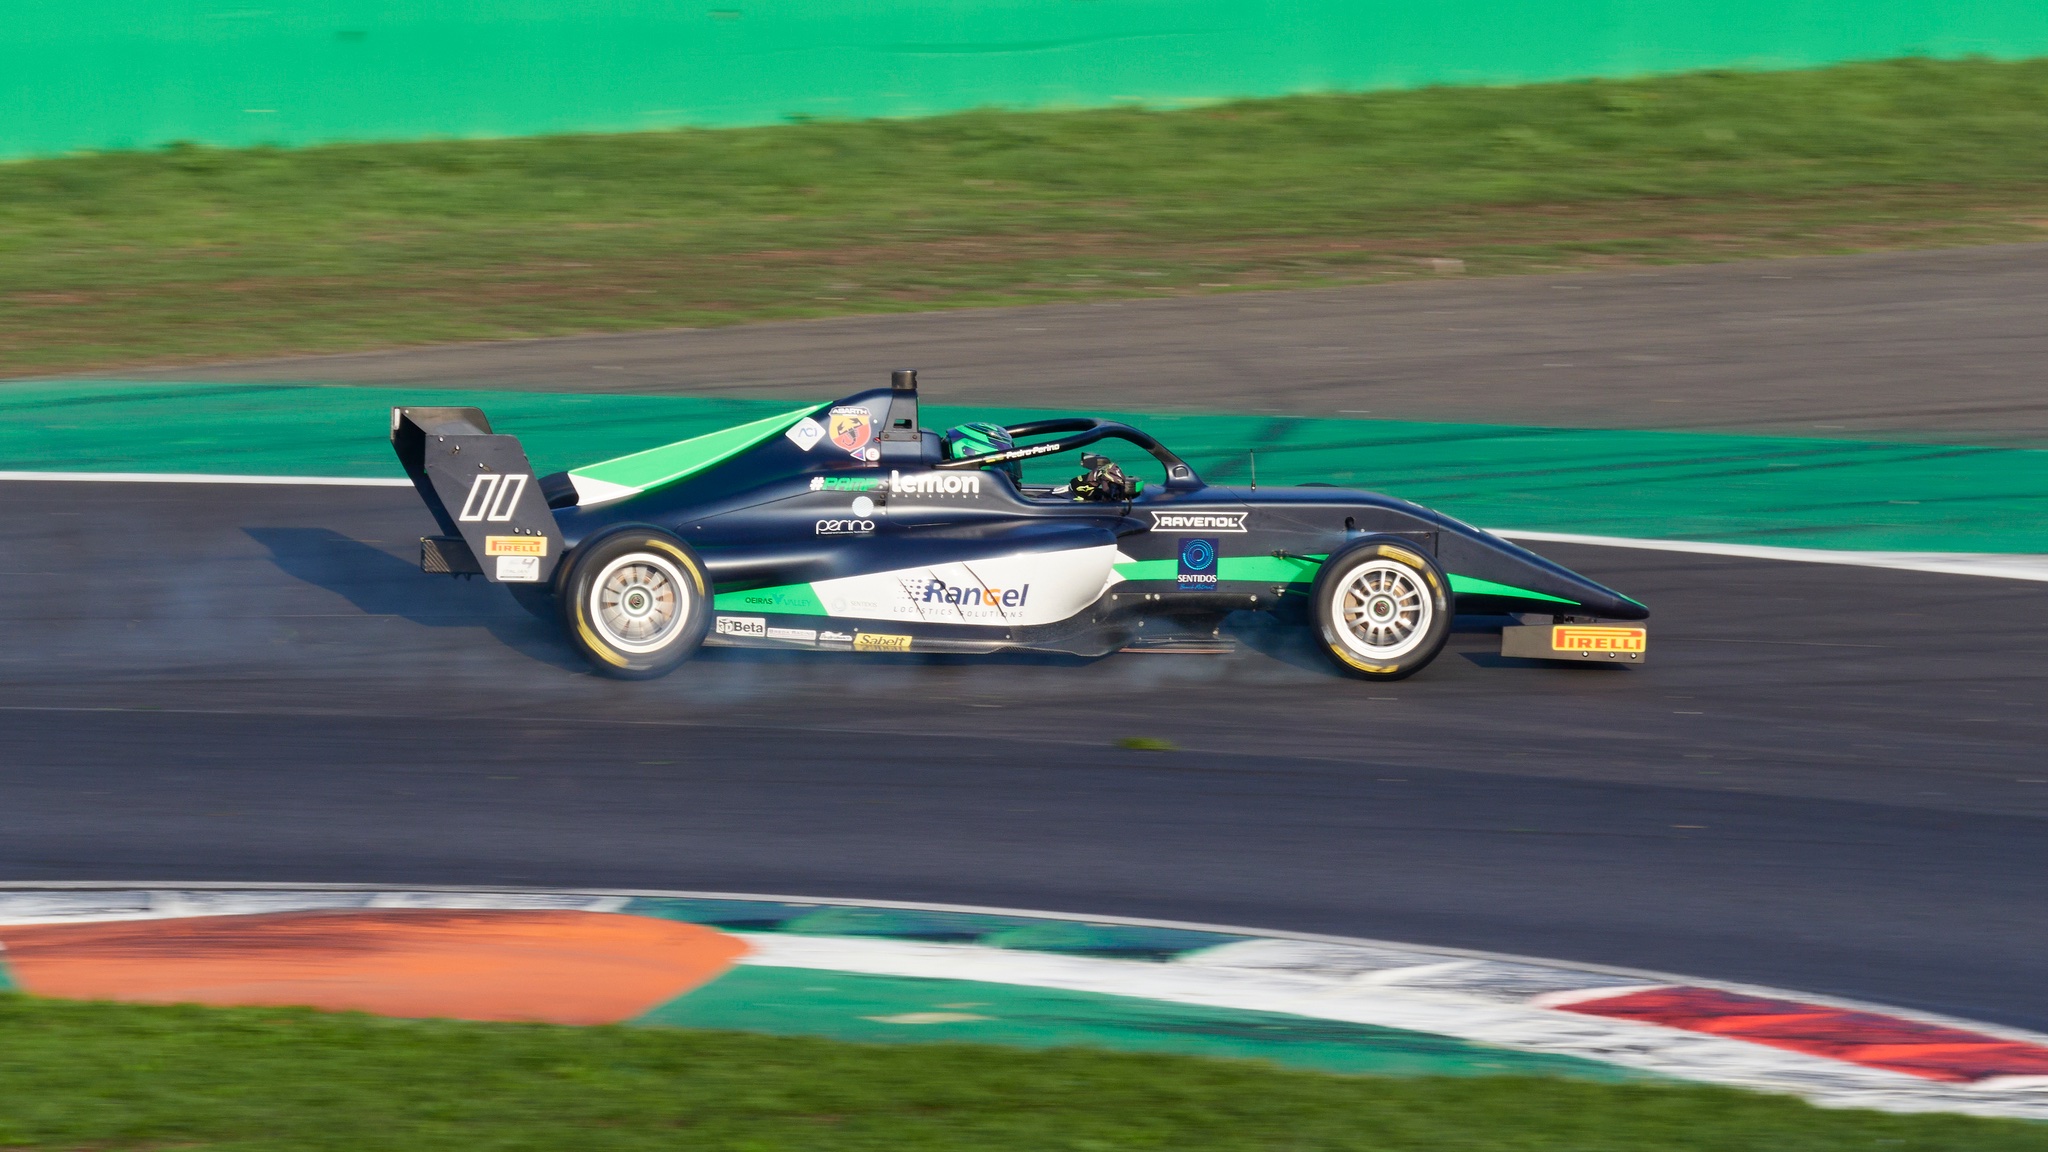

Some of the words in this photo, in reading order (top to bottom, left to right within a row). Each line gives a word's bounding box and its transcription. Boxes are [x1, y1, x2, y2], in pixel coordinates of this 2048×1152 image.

[891, 470, 980, 493] lemon
[459, 474, 528, 521] 00
[815, 519, 875, 534] perino
[1160, 516, 1238, 527] RAVENOL
[491, 540, 541, 552] PIRELLI
[1177, 574, 1217, 583] SENTIDOS
[745, 596, 773, 605] OEIRAS
[734, 621, 763, 632] Beta
[860, 634, 906, 646] Sabelt
[1555, 628, 1643, 650] PIRELLI
